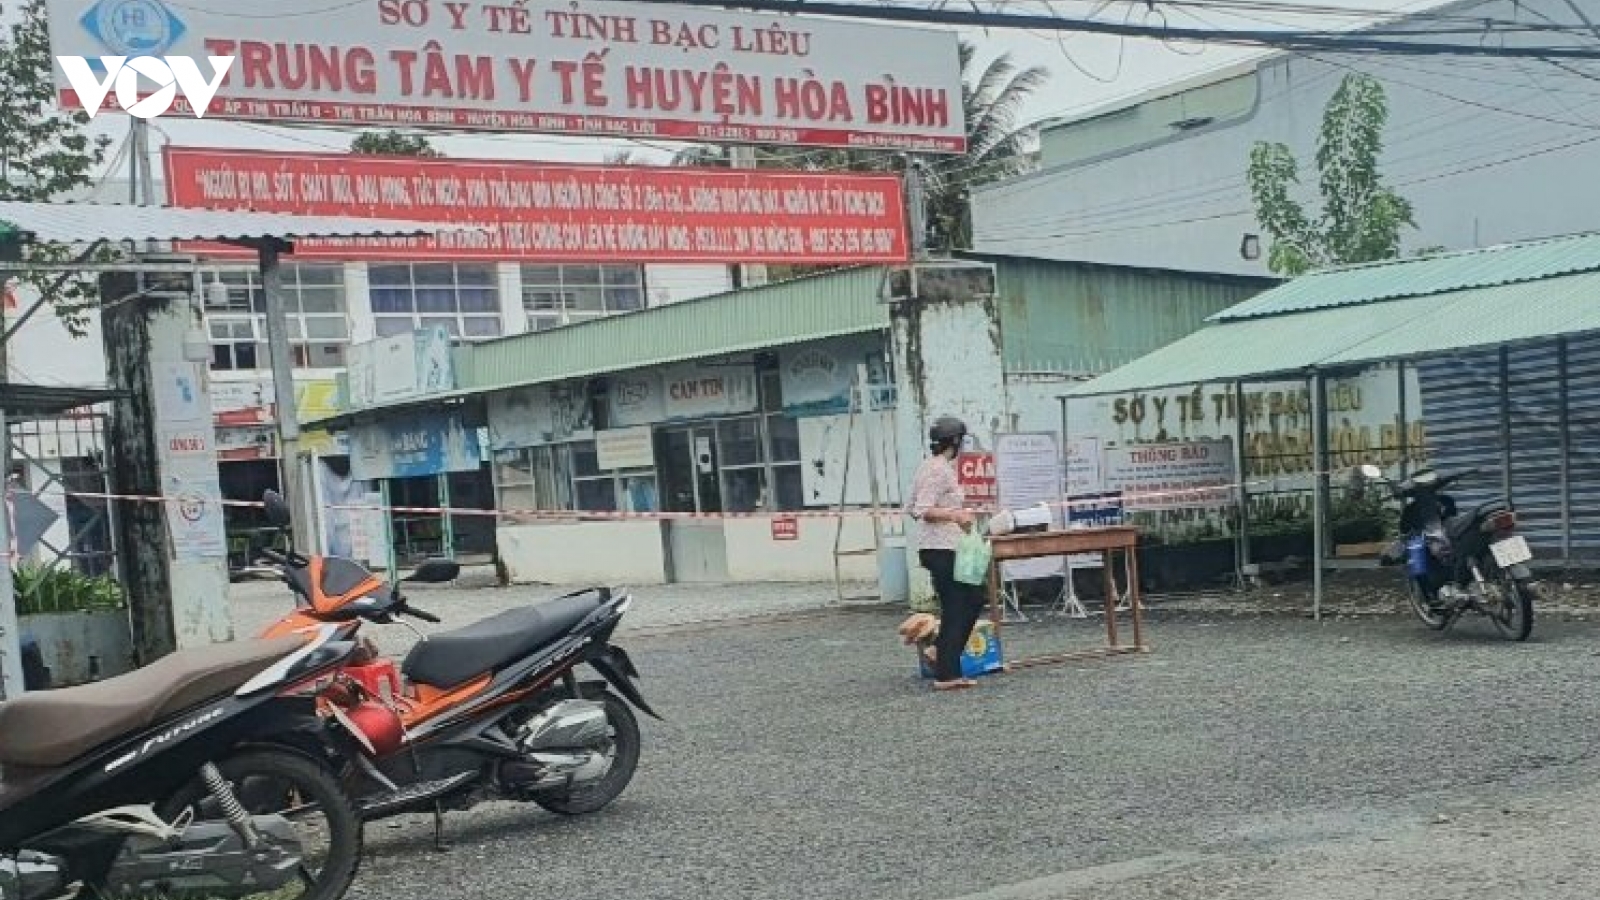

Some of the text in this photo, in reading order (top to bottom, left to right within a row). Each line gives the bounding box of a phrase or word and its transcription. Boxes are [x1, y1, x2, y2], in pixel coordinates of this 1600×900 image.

[450, 3, 475, 30] Y
[484, 0, 532, 34] TẾ
[546, 1, 639, 43] TỈNH
[651, 20, 719, 53] BẠC
[730, 22, 812, 57] LIÊU
[204, 38, 948, 128] TRUNG TÂM Y TẾ HUYỆN HÒA BÌNH
